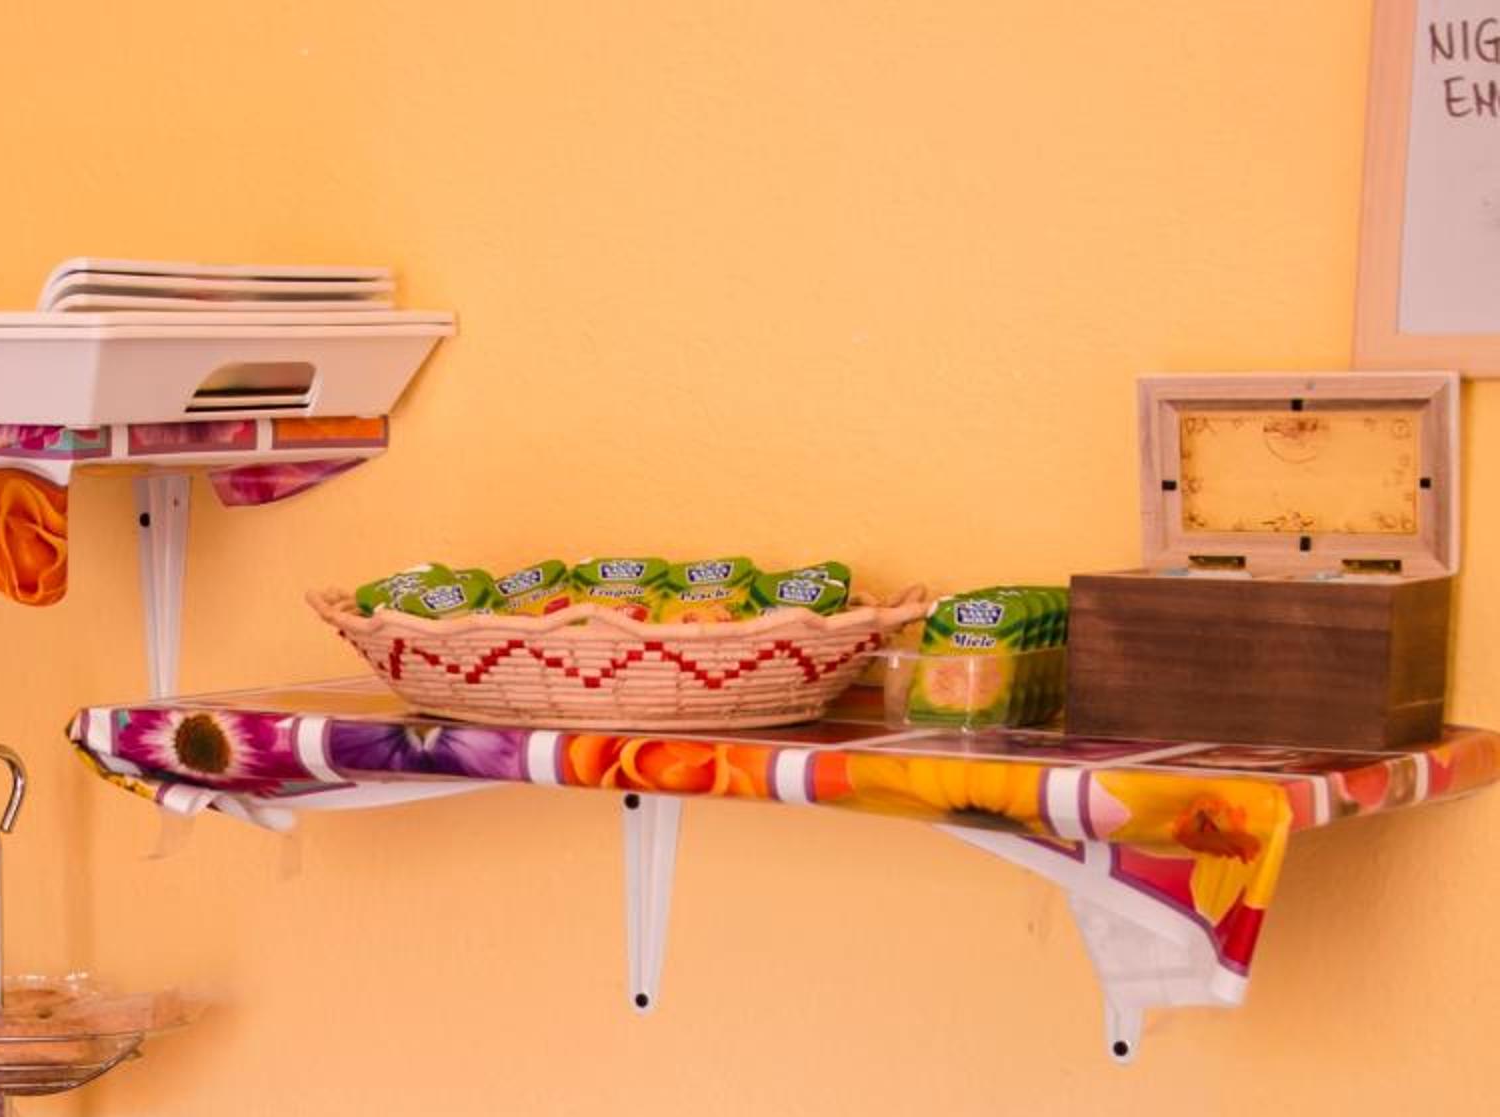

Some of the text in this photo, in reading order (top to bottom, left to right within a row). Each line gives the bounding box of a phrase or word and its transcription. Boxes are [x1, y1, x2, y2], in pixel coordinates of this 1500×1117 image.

[1429, 18, 1500, 64] NIG
[1444, 76, 1500, 118] EN
[953, 633, 995, 648] Miele
